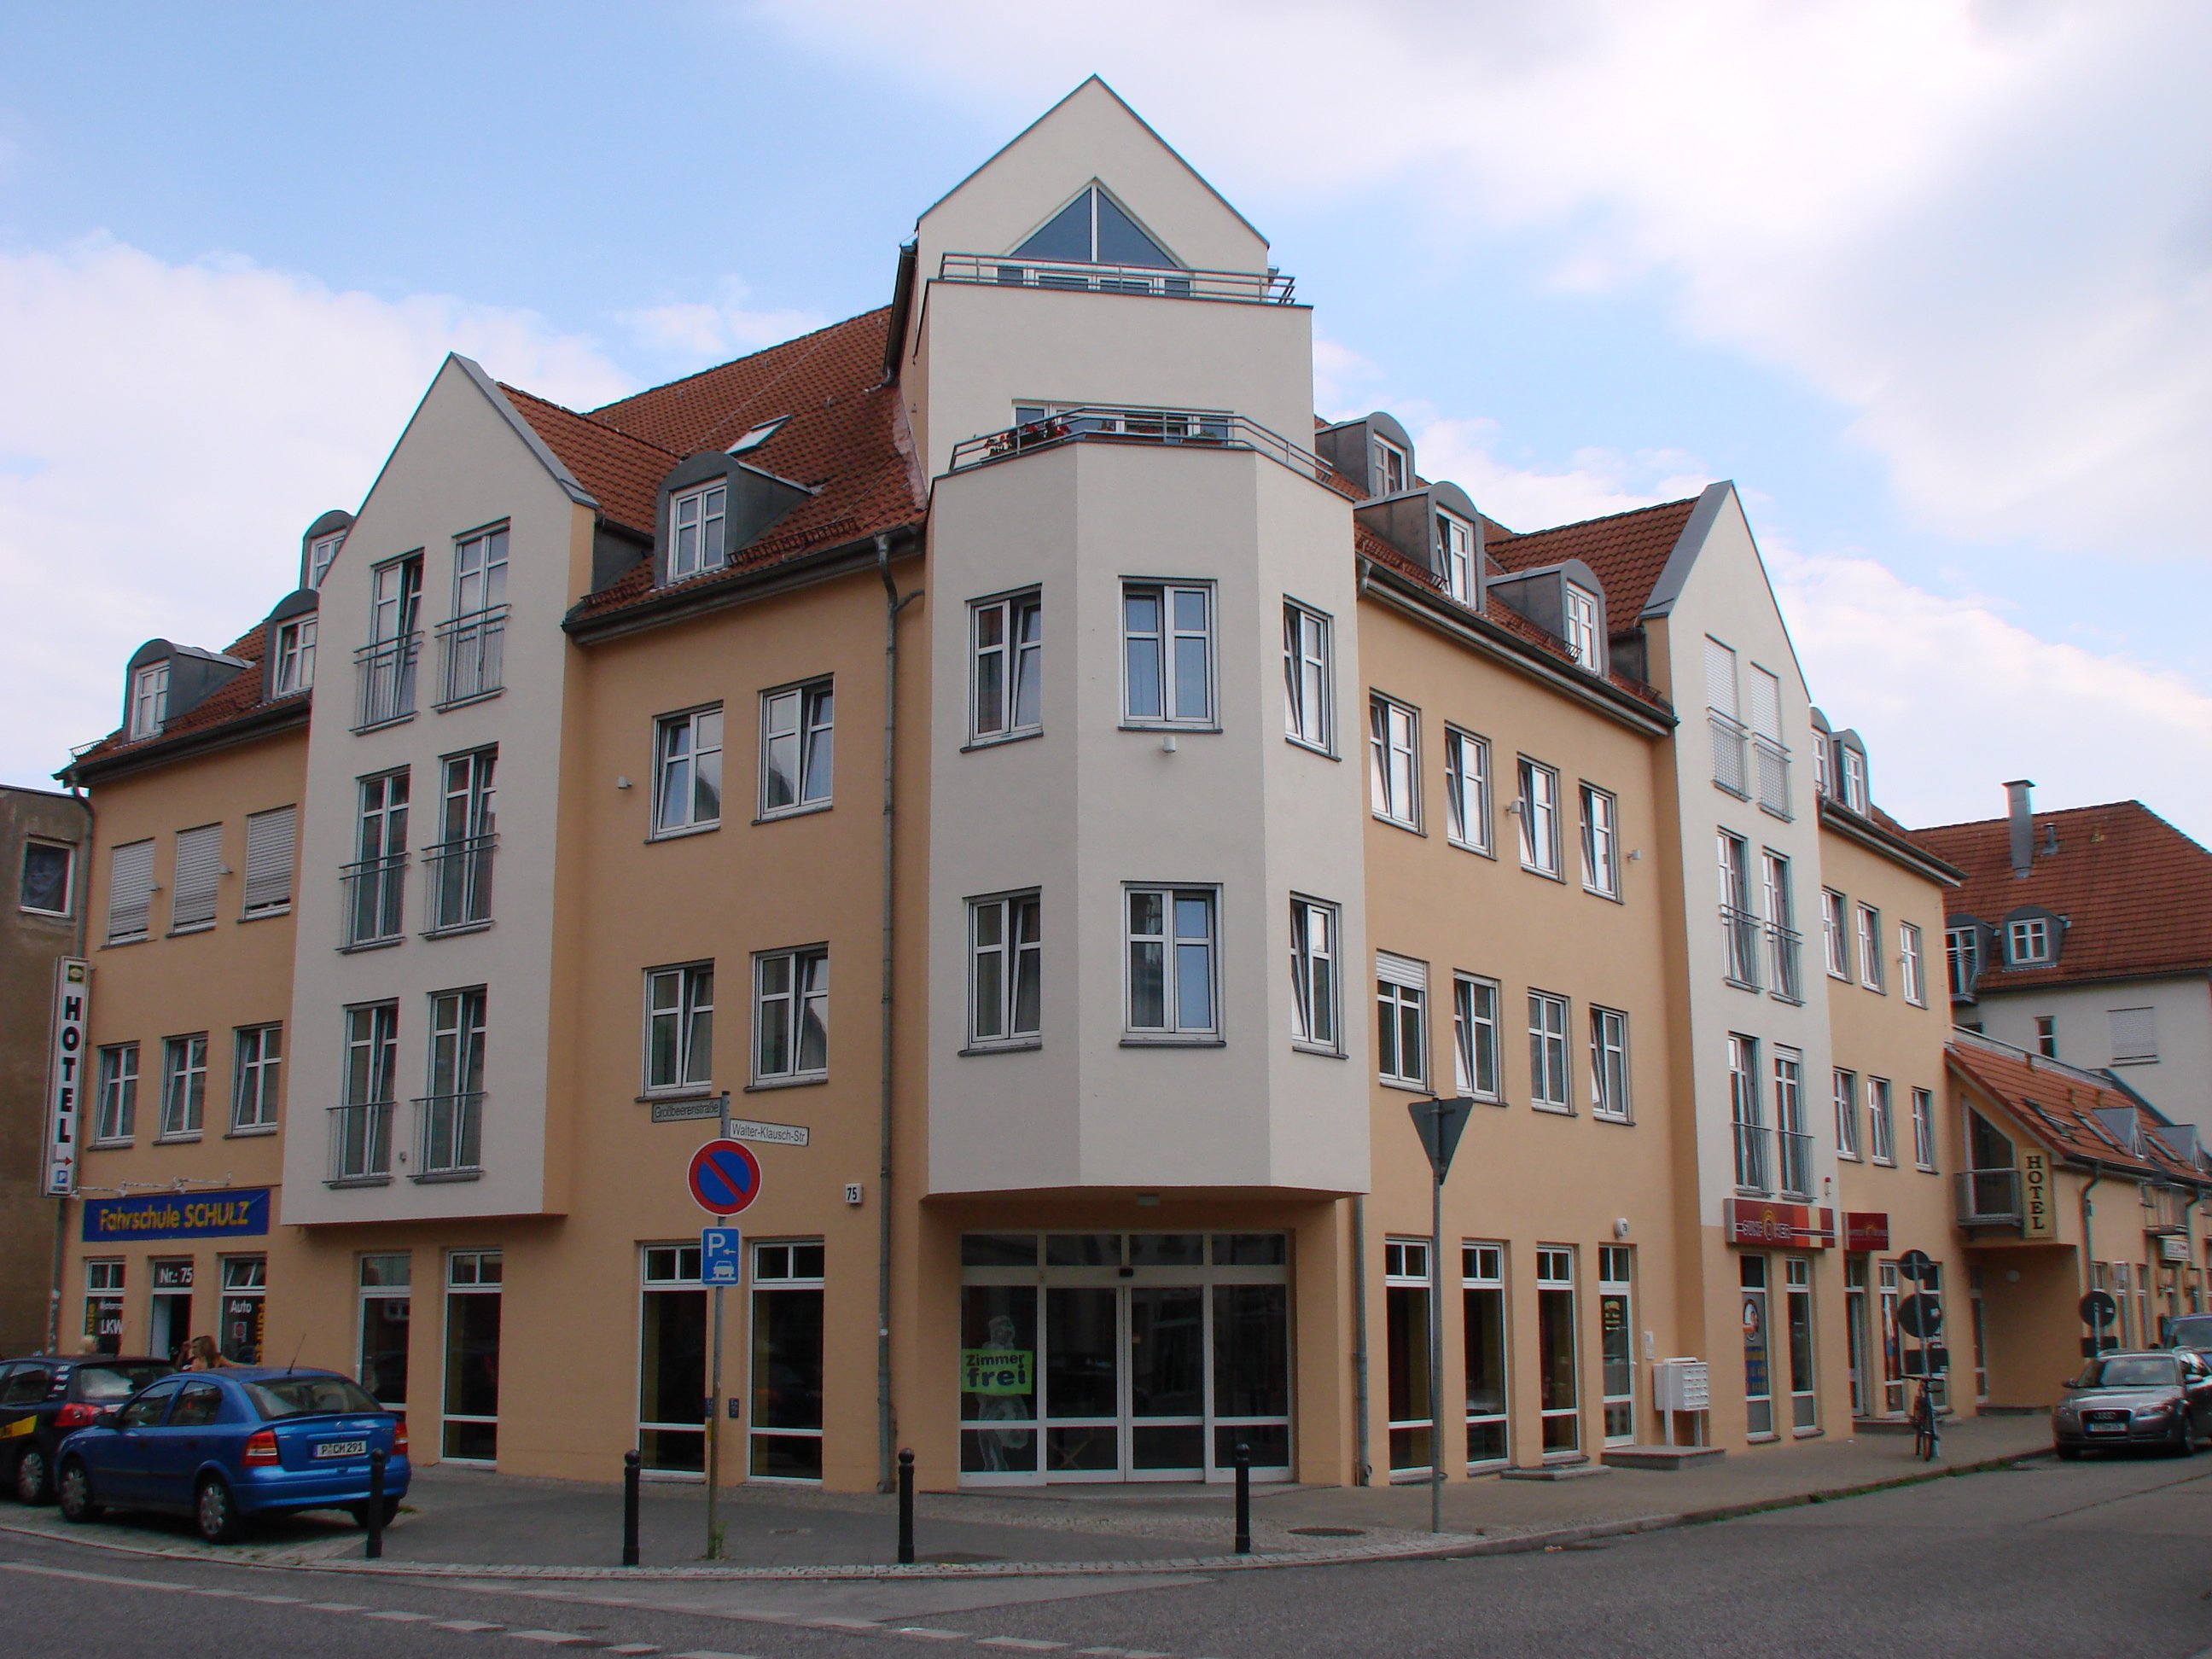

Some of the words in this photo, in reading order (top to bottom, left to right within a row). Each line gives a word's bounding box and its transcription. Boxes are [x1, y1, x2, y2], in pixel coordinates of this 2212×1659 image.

[58, 995, 83, 1144] HOTEL
[654, 1102, 719, 1120] Großbeerenstraße
[731, 1122, 805, 1143] Walter-Klausch-Str
[847, 1187, 858, 1201] 75
[2026, 1155, 2045, 1229] HOTEL
[100, 1205, 180, 1231] Fahrschule
[183, 1201, 250, 1228] SCHULZ
[708, 1233, 725, 1257] P
[180, 1267, 193, 1283] 75
[230, 1300, 252, 1313] Auto
[101, 1318, 123, 1335] LKW
[966, 1354, 1024, 1366] Zimmer
[967, 1365, 1026, 1388] frei
[347, 1441, 363, 1452] 291
